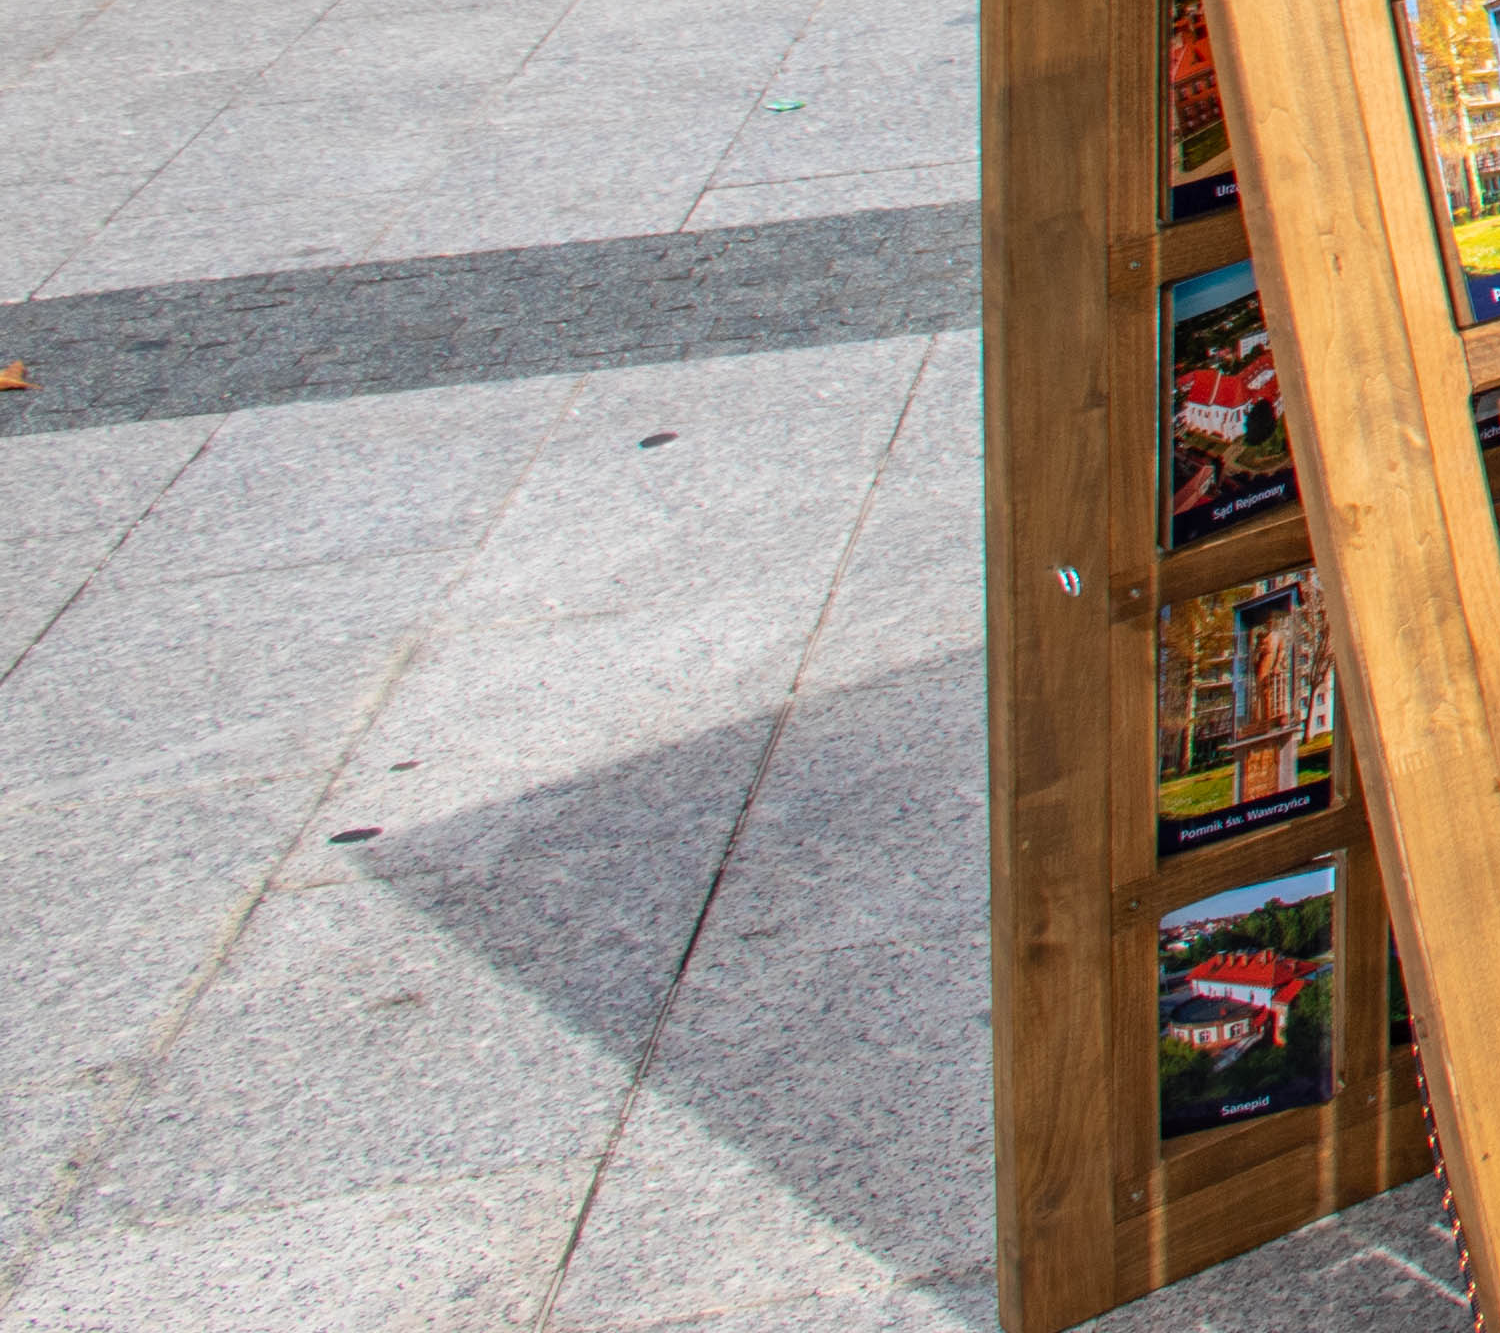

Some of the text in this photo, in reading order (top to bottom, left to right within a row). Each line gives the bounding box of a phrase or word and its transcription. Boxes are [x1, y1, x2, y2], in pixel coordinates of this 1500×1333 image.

[1211, 483, 1286, 521] Sąd Rejonowy
[1179, 794, 1312, 842] Pomnik św. Wawrzyńca
[1221, 1094, 1272, 1117] Sanepid
